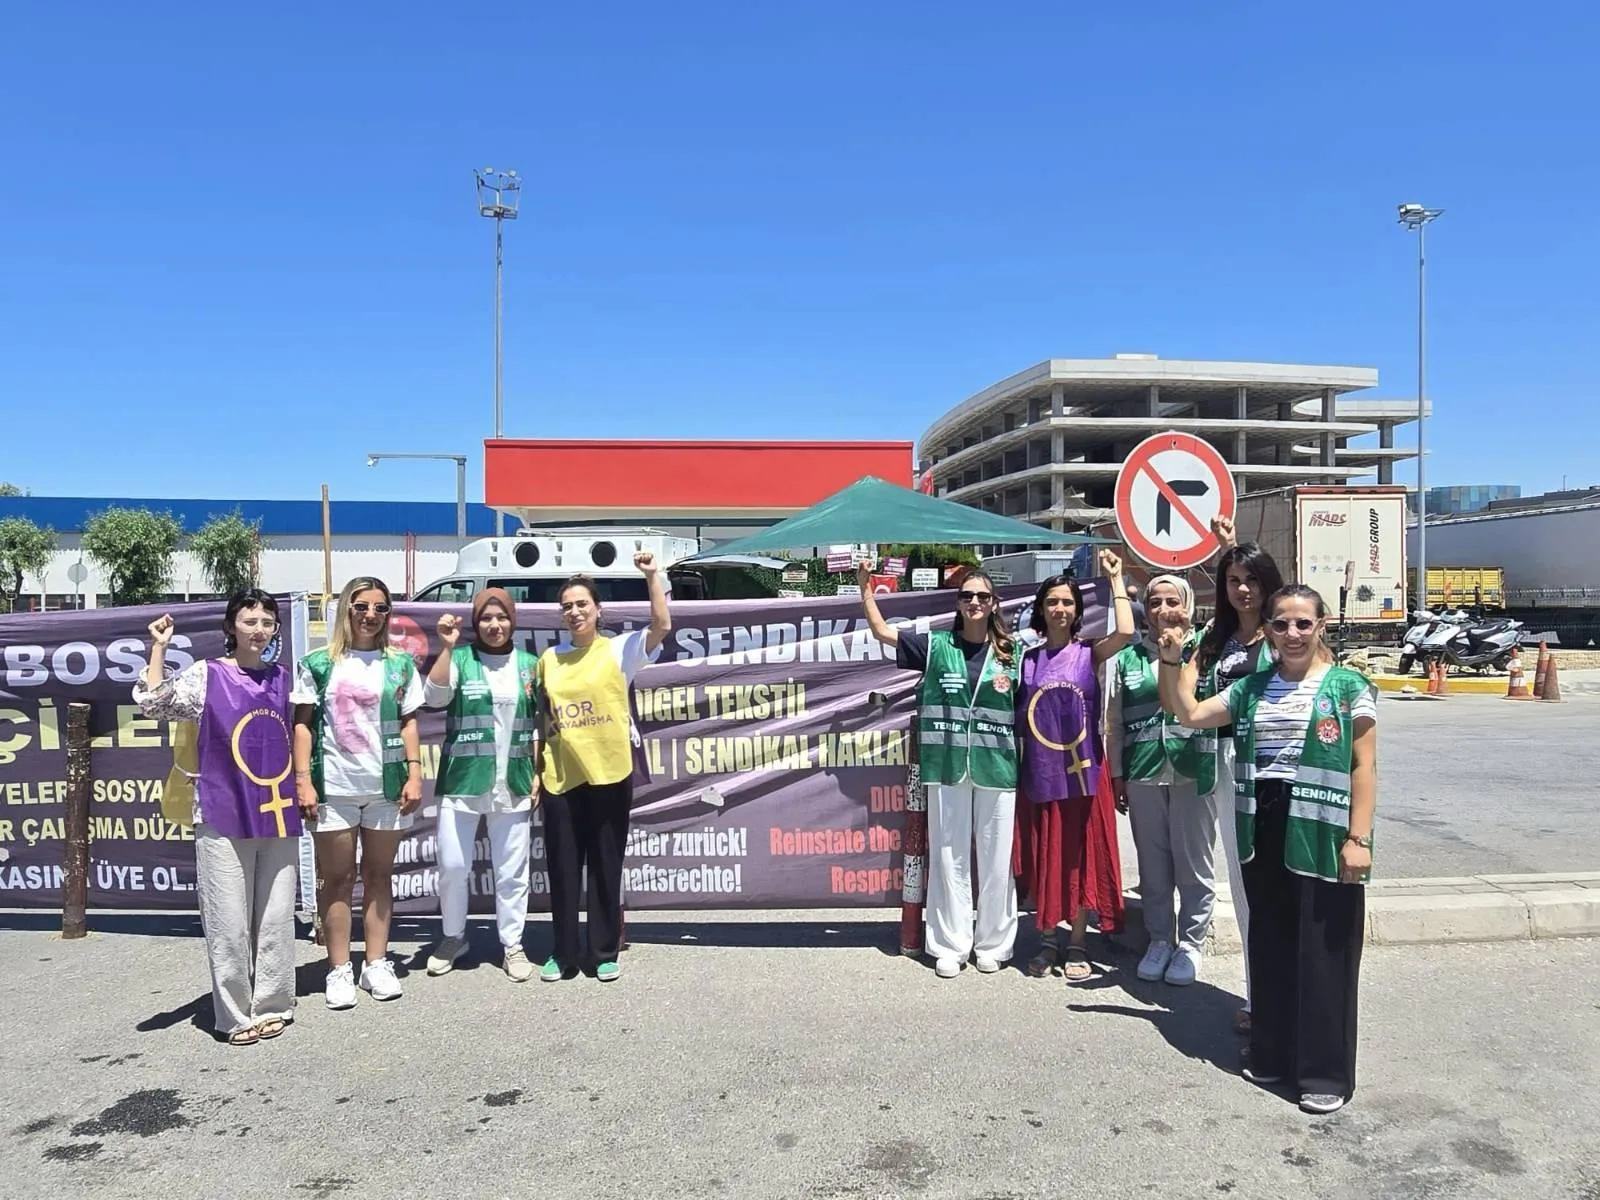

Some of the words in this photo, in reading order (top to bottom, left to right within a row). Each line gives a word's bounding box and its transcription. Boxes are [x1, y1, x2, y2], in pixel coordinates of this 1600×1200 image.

[704, 677, 810, 721] TEKSTİL
[685, 730, 812, 774] SENDİKAL
[672, 826, 748, 857] zurück!
[769, 826, 866, 856] Reinstate
[868, 824, 901, 852] the
[96, 859, 146, 890] ÜYE
